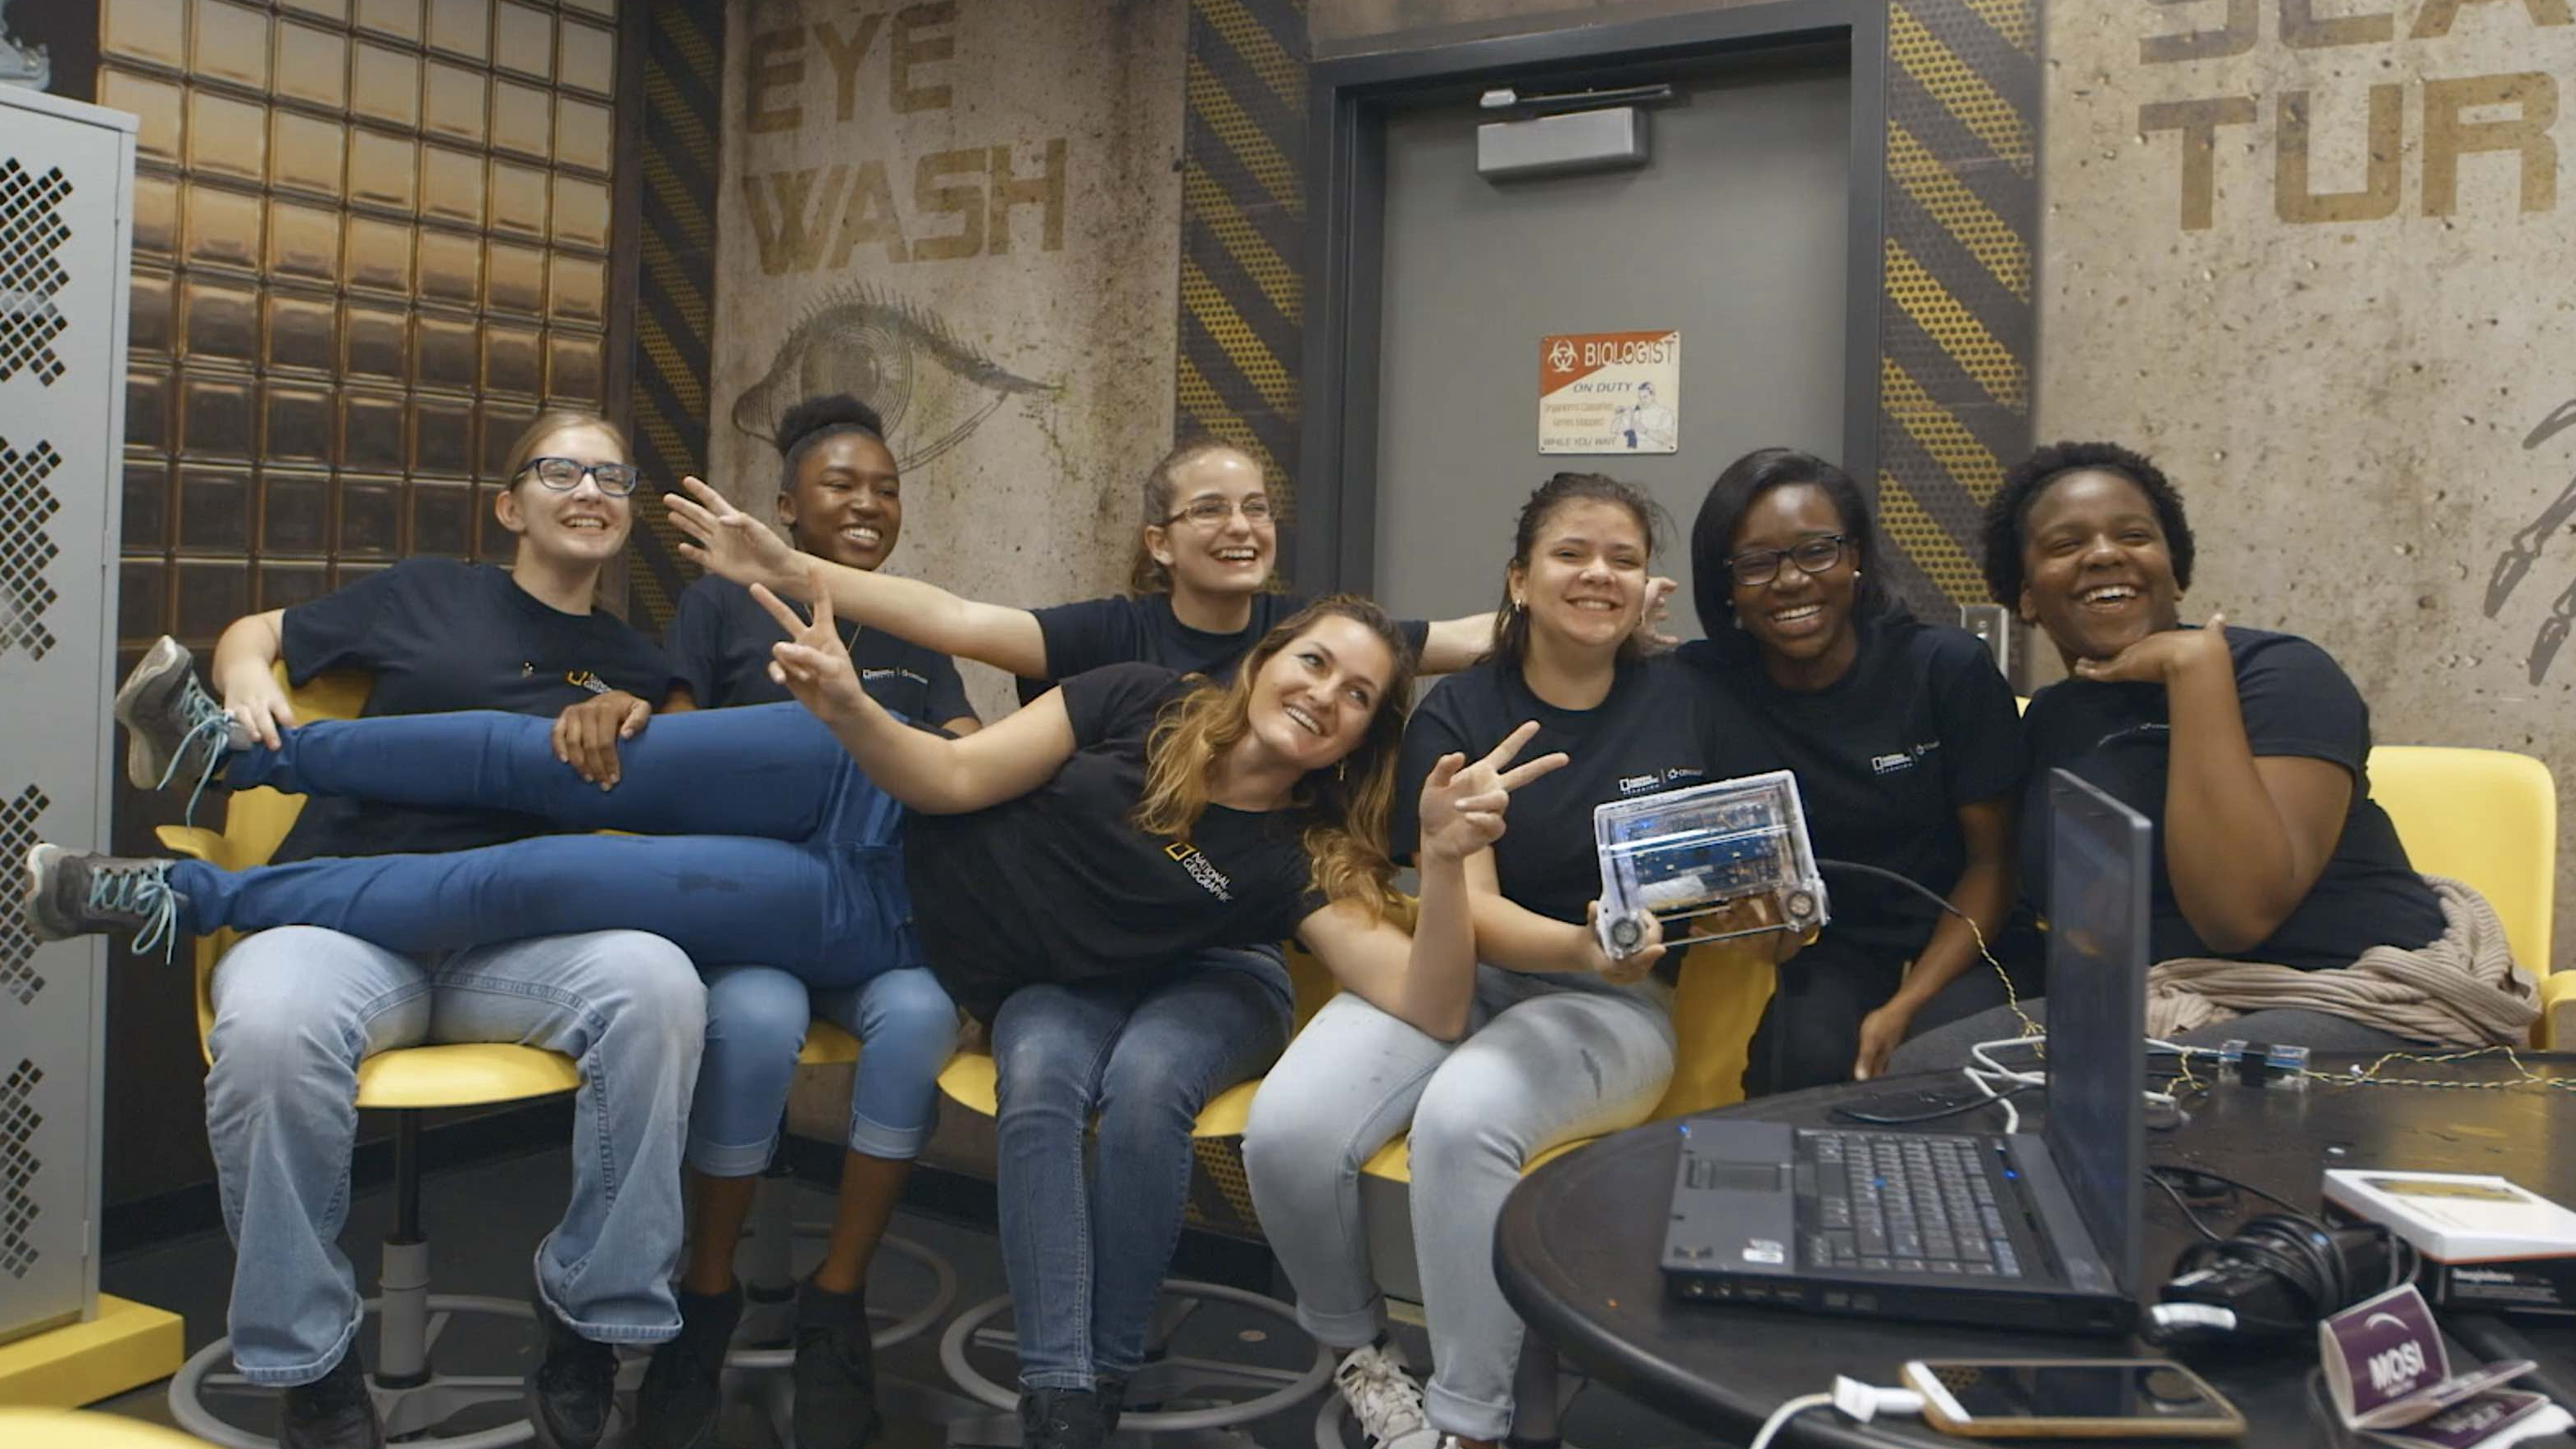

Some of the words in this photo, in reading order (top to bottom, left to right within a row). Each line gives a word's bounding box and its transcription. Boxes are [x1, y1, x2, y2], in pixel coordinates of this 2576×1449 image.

[746, 0, 956, 134] EYE
[743, 138, 1066, 276] WASH
[1584, 340, 1674, 367] BIOLOGIST
[1574, 382, 1594, 393] ON
[1597, 381, 1633, 393] DUTY
[1191, 852, 1230, 890] NATIONAL
[2368, 1339, 2427, 1391] MOSI
